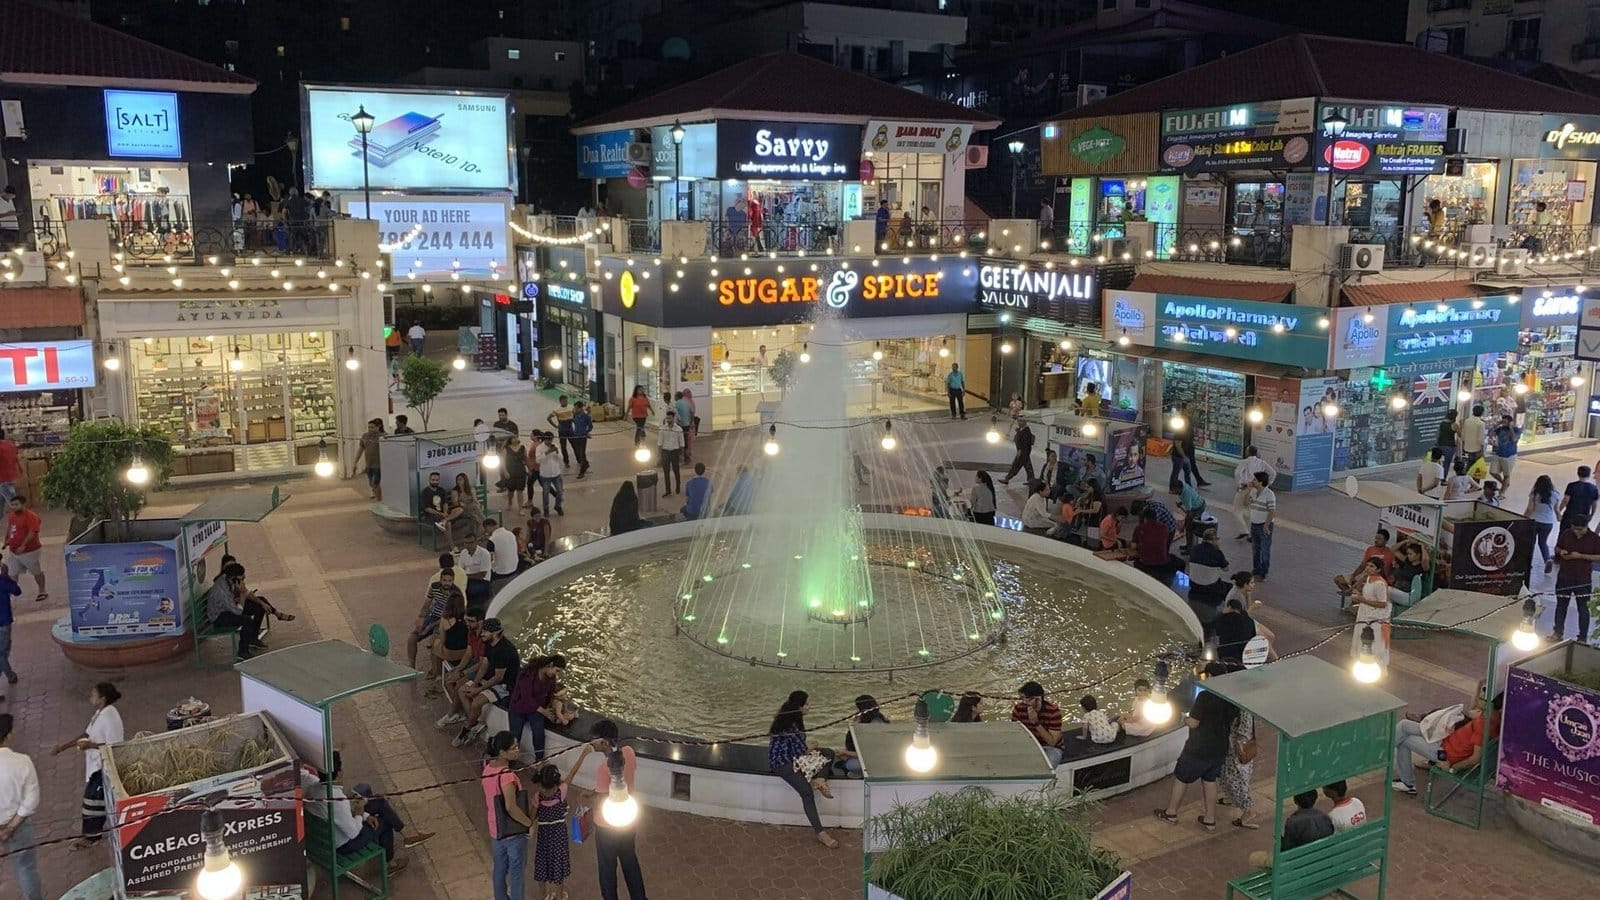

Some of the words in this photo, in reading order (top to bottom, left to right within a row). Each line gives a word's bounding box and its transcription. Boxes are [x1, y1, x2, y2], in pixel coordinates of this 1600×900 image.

[457, 103, 497, 112] SAMSUNG
[1166, 108, 1247, 132] FUJIFILM
[1345, 131, 1372, 139] Imaging
[1373, 131, 1398, 139] Service
[755, 128, 829, 161] Savvy
[1376, 143, 1406, 157] Natraj
[1406, 144, 1444, 156] FRAMES
[384, 209, 418, 223] YOUR
[422, 209, 438, 223] AD
[441, 209, 471, 223] HERE
[418, 231, 453, 250] 244
[459, 231, 494, 250] 444
[719, 276, 819, 305] SUGAR
[826, 270, 858, 308] &
[863, 272, 939, 299] SPICE
[980, 265, 1091, 300] GEETANJALI
[177, 310, 283, 321] AYURVEDA
[1350, 327, 1380, 343] Apollo
[426, 447, 447, 459] 9780
[447, 445, 462, 456] 244
[463, 443, 477, 453] 444
[1523, 750, 1551, 770] THE
[223, 812, 282, 837] XPRESS
[260, 833, 278, 845] AND
[127, 869, 171, 886] ASSURED
[240, 836, 292, 856] OWNERSHIP
